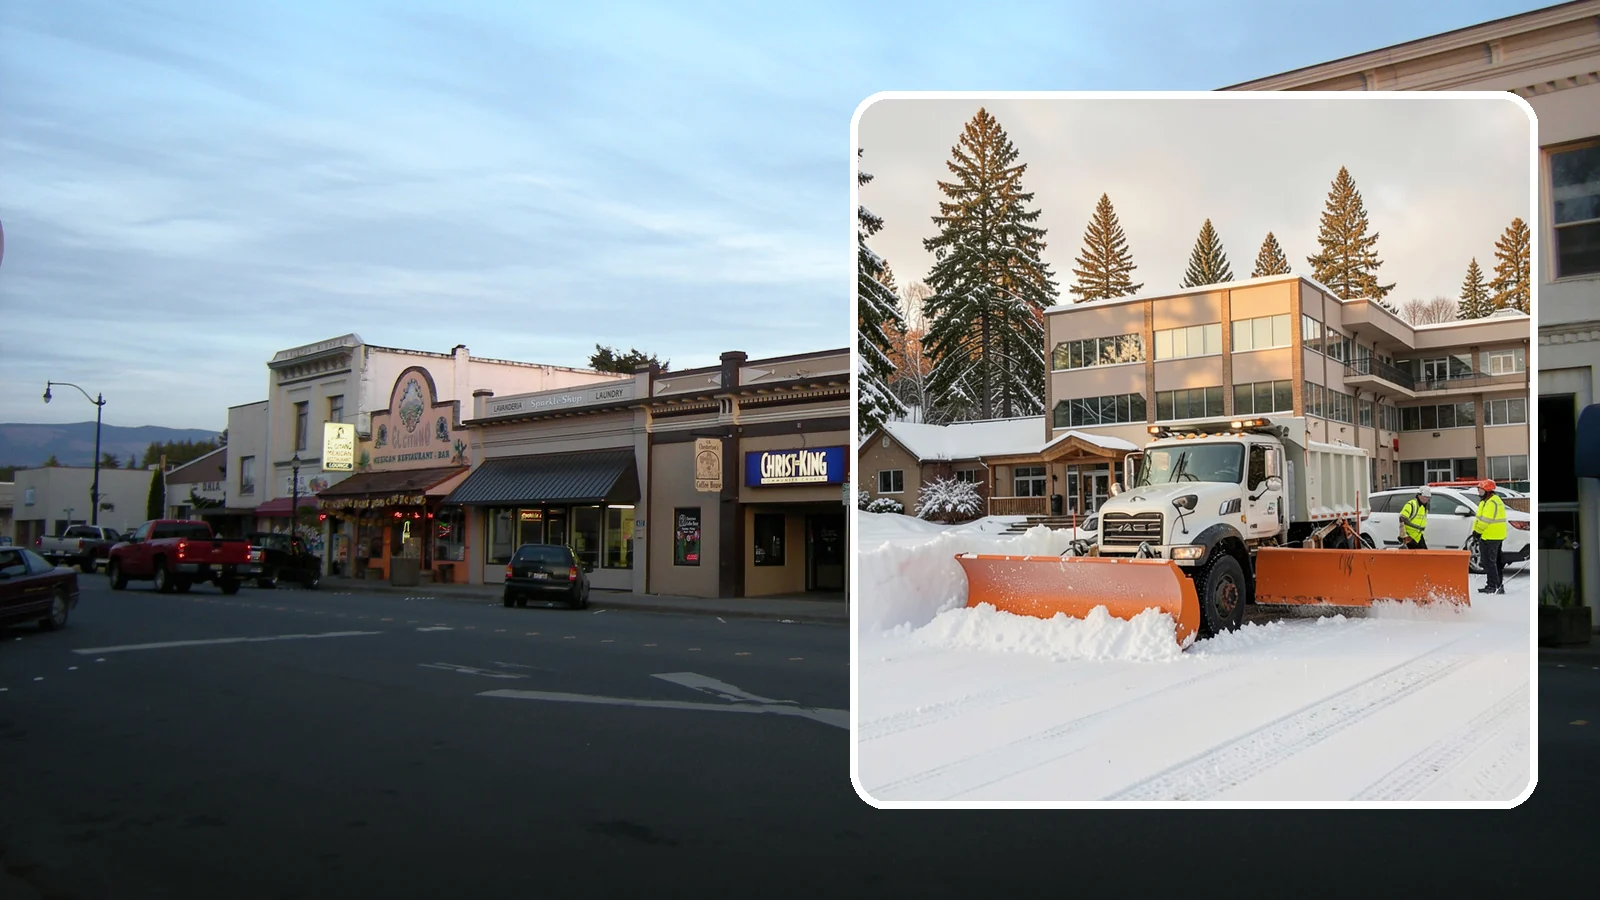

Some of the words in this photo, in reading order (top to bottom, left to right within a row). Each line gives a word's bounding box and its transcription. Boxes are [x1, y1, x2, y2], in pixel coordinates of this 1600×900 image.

[595, 389, 623, 400] LAUNDRY
[493, 402, 522, 412] LAVANDERIA
[531, 398, 560, 409] Sparkle
[561, 394, 582, 405] Shop
[374, 455, 396, 463] MEXICAN
[397, 451, 434, 462] RESTAURANT
[437, 450, 450, 459] BAR
[761, 452, 797, 478] CHRIST
[799, 450, 827, 476] KING
